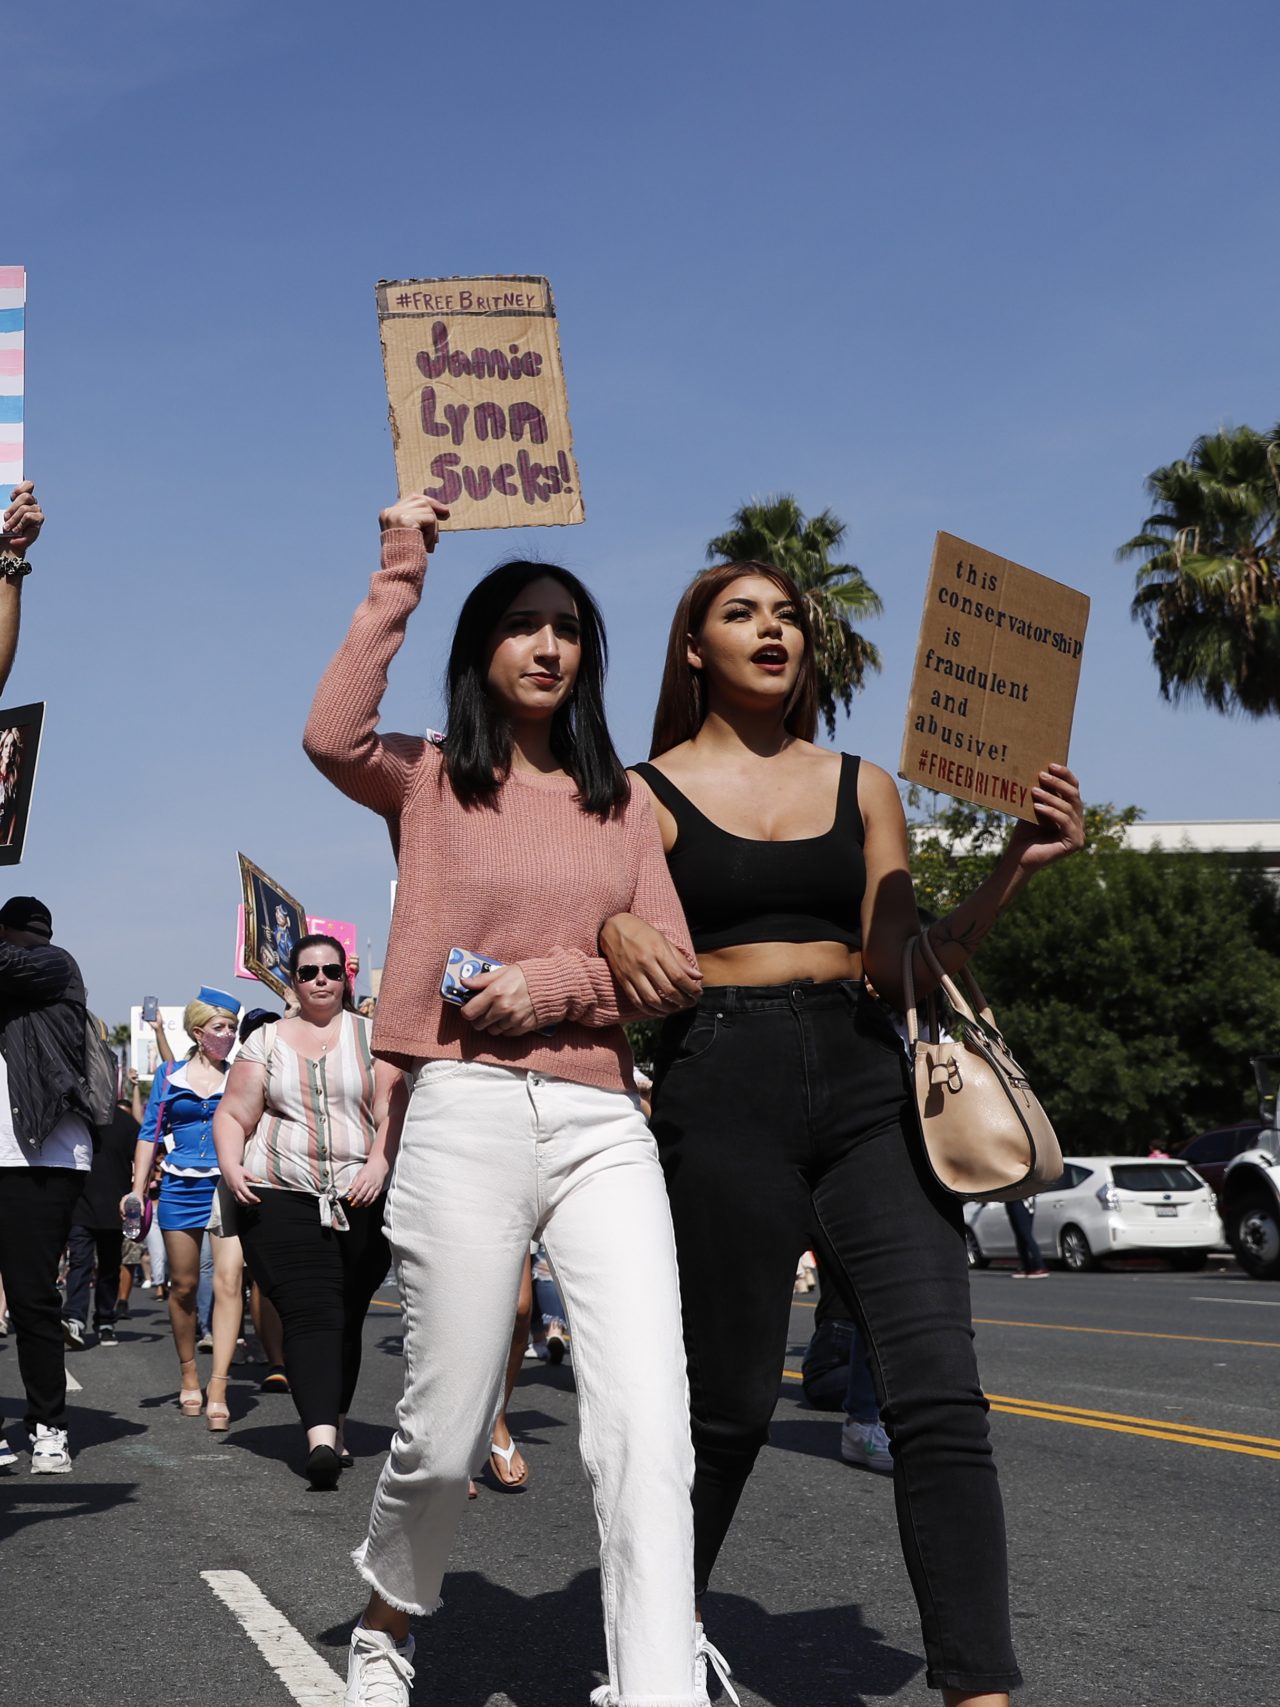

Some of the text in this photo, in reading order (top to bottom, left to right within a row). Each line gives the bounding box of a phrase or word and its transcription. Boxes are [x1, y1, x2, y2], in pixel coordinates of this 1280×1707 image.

[416, 320, 544, 381] Jamie
[420, 385, 549, 446] Lynn
[423, 449, 574, 505] Sucks!
[956, 560, 998, 592] this
[938, 586, 1083, 659] conservatorship
[944, 626, 961, 648] is
[924, 648, 1029, 703] fraudulent
[931, 689, 968, 718] and
[914, 714, 1008, 763] abusive!
[918, 749, 1028, 809] #FREEBRITNEY
